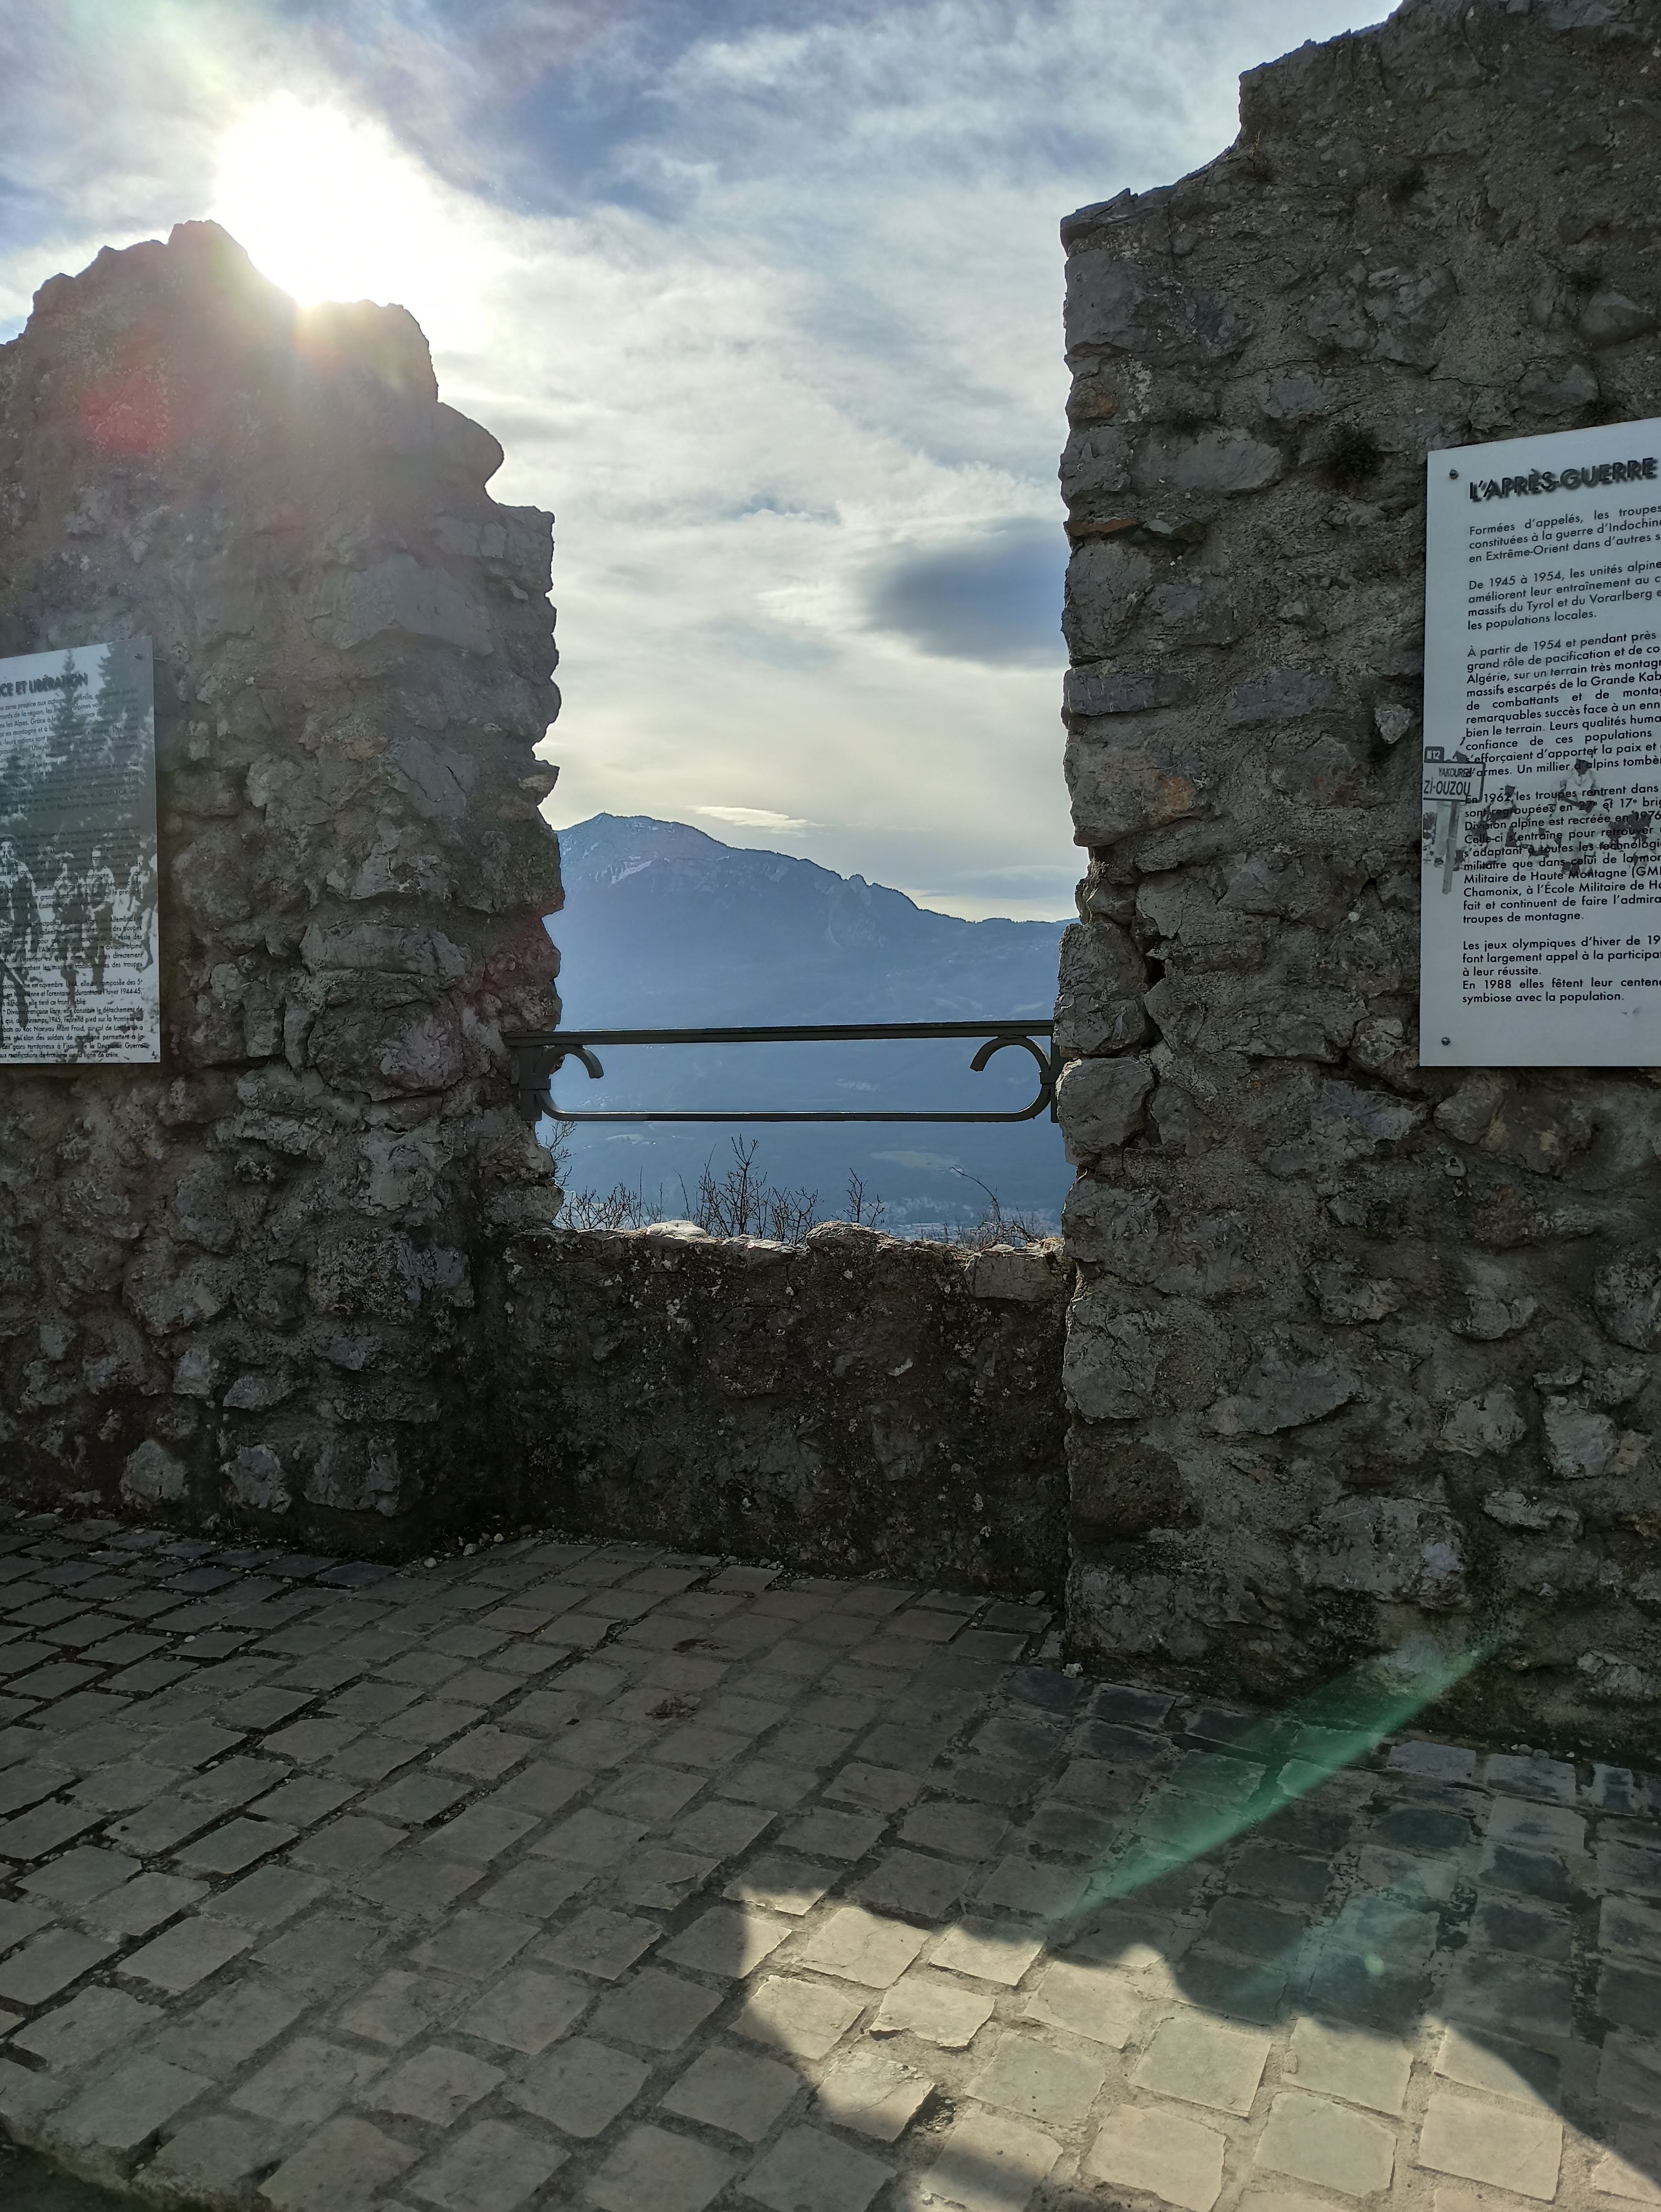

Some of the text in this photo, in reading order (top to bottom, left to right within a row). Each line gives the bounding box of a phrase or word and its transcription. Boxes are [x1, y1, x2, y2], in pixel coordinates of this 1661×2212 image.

[1470, 457, 1655, 499] L'APRÈS-GUERRE
[1470, 522, 1515, 536] Formées
[1524, 513, 1583, 529] d'appelés,
[1594, 510, 1609, 520] les
[1469, 528, 1594, 550] constituées guerre
[1486, 535, 1651, 561] Extrême-Orient dans d'autres
[1469, 580, 1484, 590] De
[1490, 575, 1516, 587] 1945
[1533, 570, 1565, 583] 1954,
[1570, 568, 1585, 578] les
[1590, 564, 1623, 576] unités
[1468, 577, 1630, 604] améliorent leur entraînement
[1468, 590, 1652, 617] massifs Tyrol Vorarlberg
[1468, 609, 1597, 630] les populations locales.
[1467, 630, 1657, 658] À partir de 1954 pendant près
[1467, 649, 1610, 672] grand rôle pacification
[1466, 672, 1510, 685] Algérie,
[1550, 664, 1587, 676] terrain
[1590, 662, 1611, 673] très
[1467, 673, 1635, 697] massifs escarpés Grande
[1492, 692, 1583, 708] combattants et
[1466, 704, 1608, 724] remarquables succès face
[1466, 716, 1627, 738] bien terrain. Leurs qualités
[1465, 729, 1652, 751] confiance ces populations
[1536, 745, 1599, 760] d'apporter
[1616, 742, 1642, 756] paix
[1517, 764, 1532, 774] Un
[1536, 761, 1573, 773] millier
[1517, 791, 1531, 800] les
[1582, 785, 1626, 796] rentrent
[1631, 784, 1659, 794] dans
[1511, 817, 1544, 830] alpine
[1549, 817, 1564, 826] est
[1568, 814, 1610, 825] recréée
[1569, 830, 1595, 841] pour
[1464, 841, 1594, 858] s'adaptant les
[1513, 861, 1533, 870] que
[1539, 857, 1565, 866] dans
[1603, 854, 1617, 864] de
[1464, 873, 1509, 884] Militaire
[1531, 871, 1563, 881] Haute
[1463, 881, 1626, 897] Chamonix, l'École Militaire
[1463, 896, 1608, 911] fait continuent faire
[1463, 912, 1584, 925] troupes montagne.
[1463, 936, 1621, 951] Les jeux olympiques d'hiver
[1462, 950, 1604, 964] font largement appel la
[1473, 965, 1542, 976] leur réussite.
[1462, 977, 1613, 990] En 1988 elles fêtent leur
[1462, 992, 1512, 1005] symbiose
[1560, 990, 1624, 1004] population.
